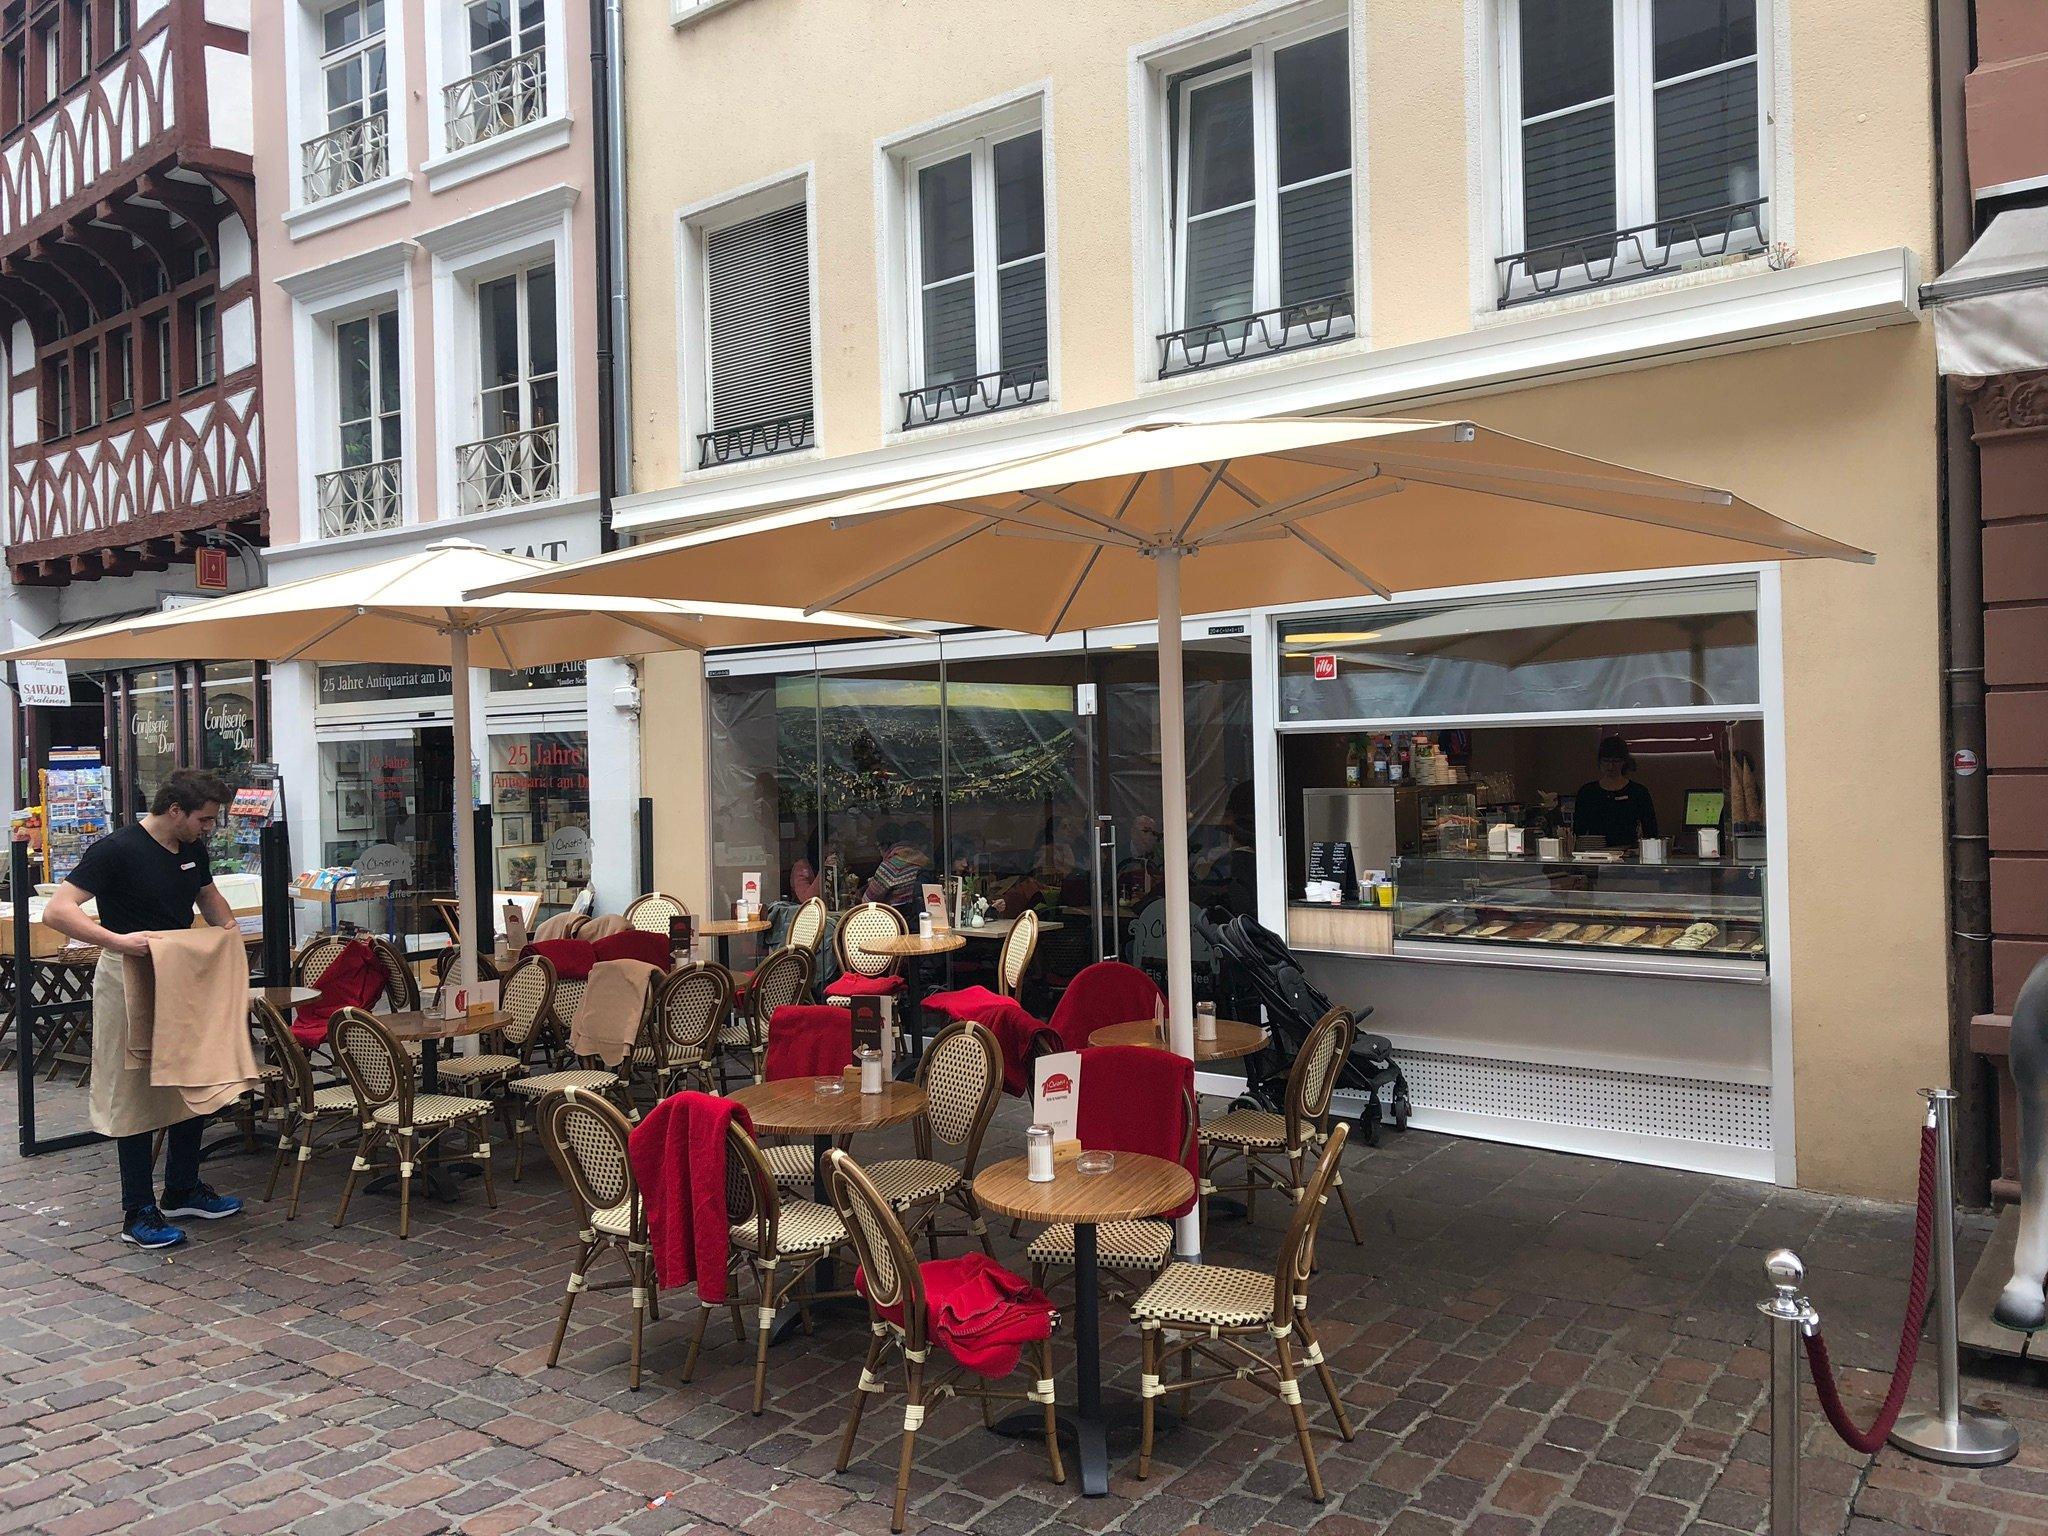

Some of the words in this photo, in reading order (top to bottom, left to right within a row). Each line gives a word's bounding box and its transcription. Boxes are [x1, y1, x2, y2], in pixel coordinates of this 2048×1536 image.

[1316, 659, 1333, 675] illy
[23, 684, 66, 695] SAWADE
[323, 678, 335, 691] 25
[337, 675, 363, 690] Jahre
[366, 671, 419, 690] Antiquariat
[421, 673, 435, 684] am
[438, 668, 453, 682] Do
[132, 710, 169, 740] Confiserie
[205, 703, 247, 735] Confiserie
[508, 745, 528, 765] 25
[535, 743, 581, 766] Jahre
